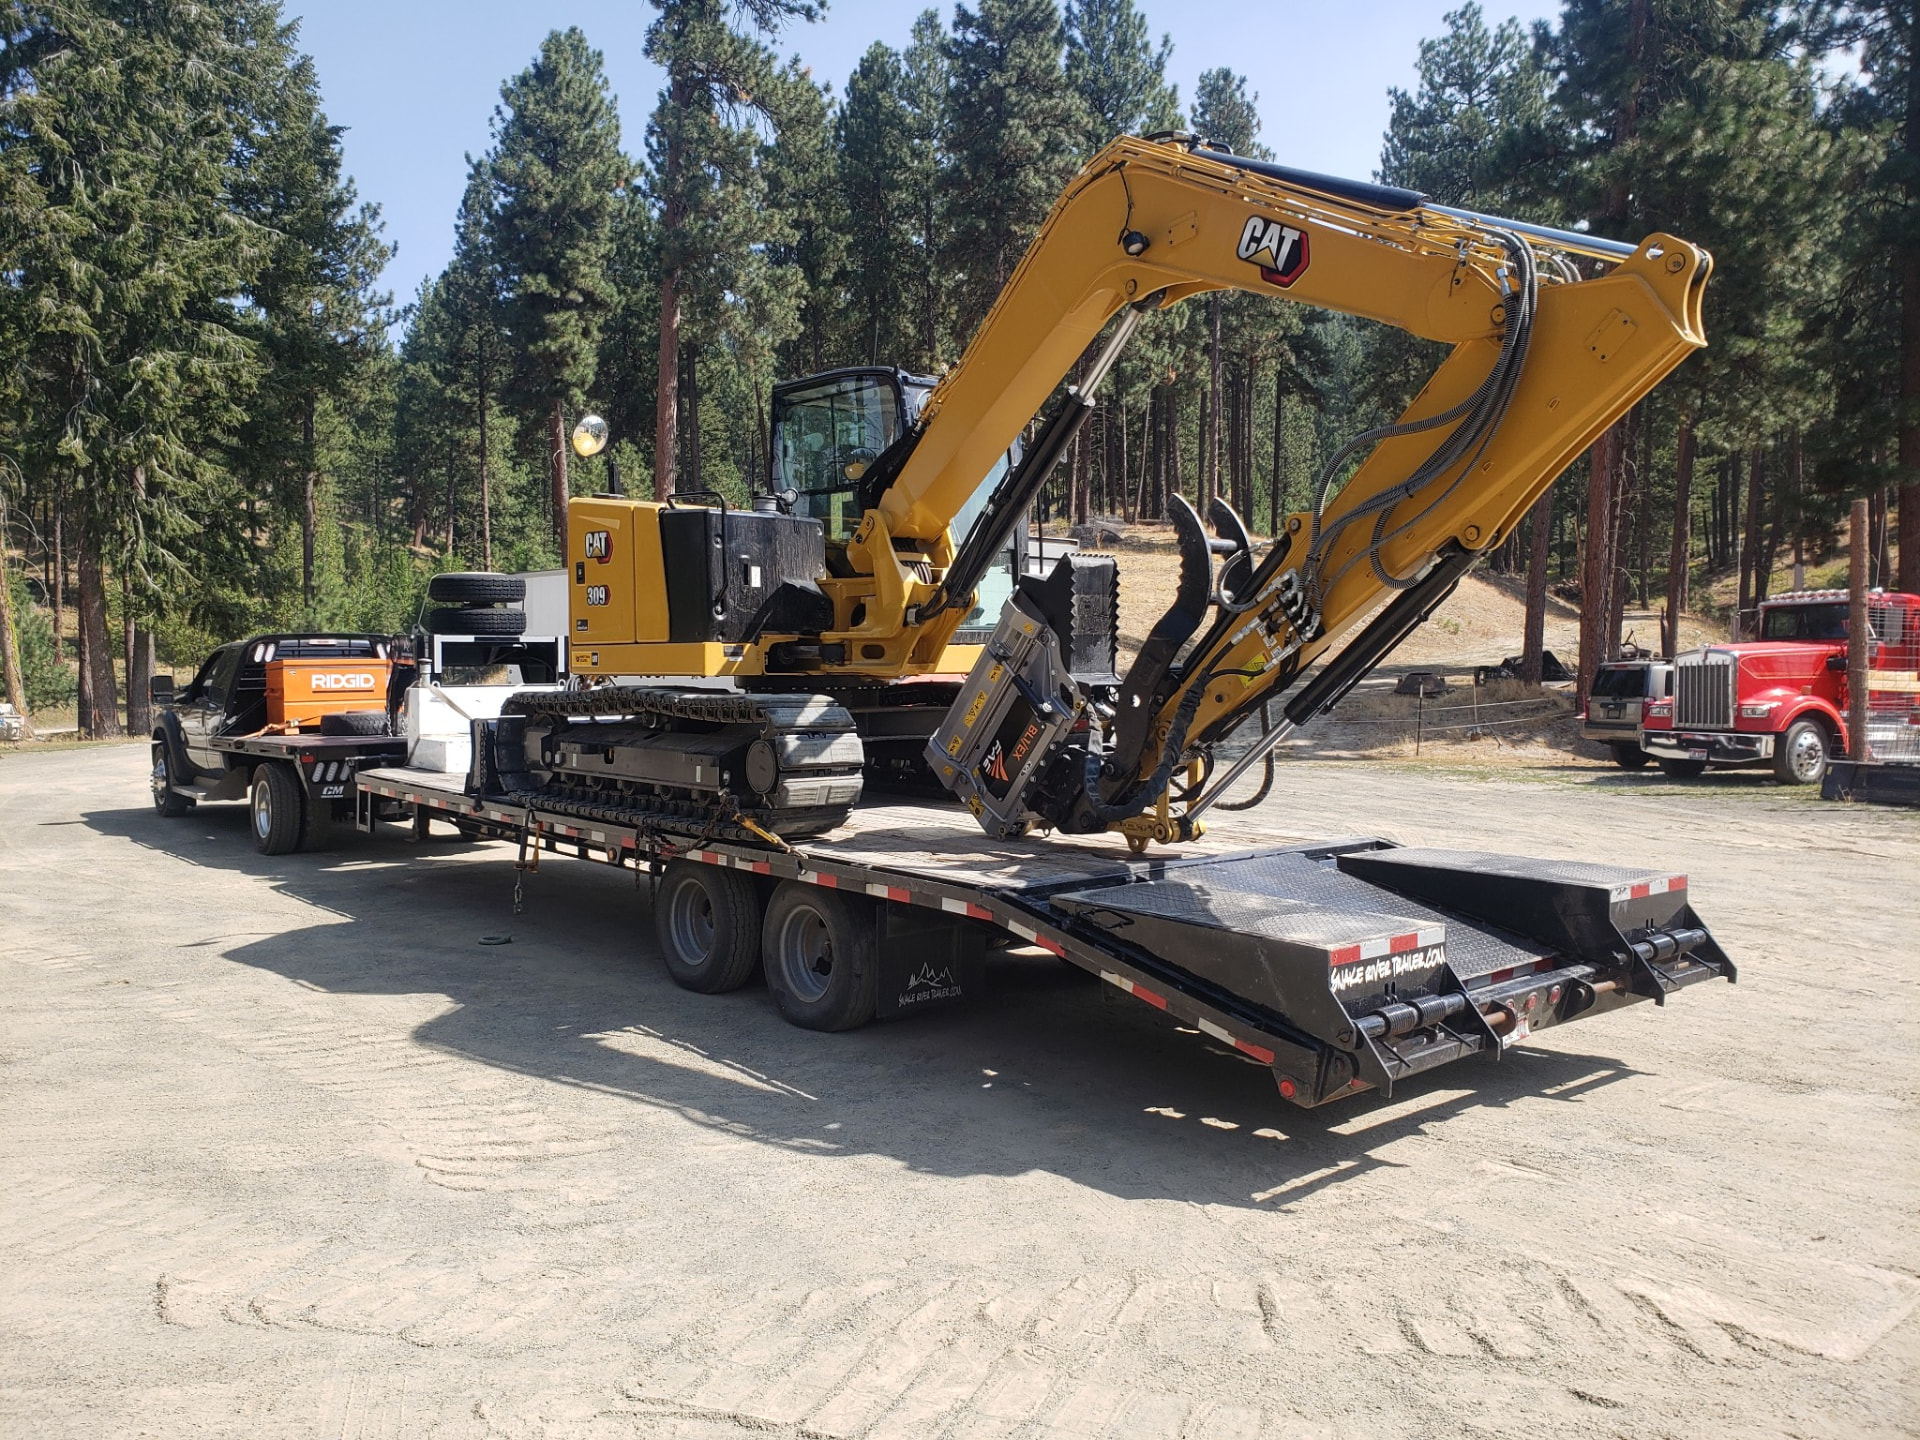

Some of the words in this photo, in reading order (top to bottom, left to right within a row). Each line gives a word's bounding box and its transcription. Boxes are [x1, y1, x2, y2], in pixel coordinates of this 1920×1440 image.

[1238, 216, 1301, 272] CAT
[585, 532, 608, 558] CAT
[587, 586, 606, 605] 309
[311, 674, 375, 689] RIDGID
[1330, 966, 1364, 993] SNAKE
[1365, 958, 1391, 983] RIVER
